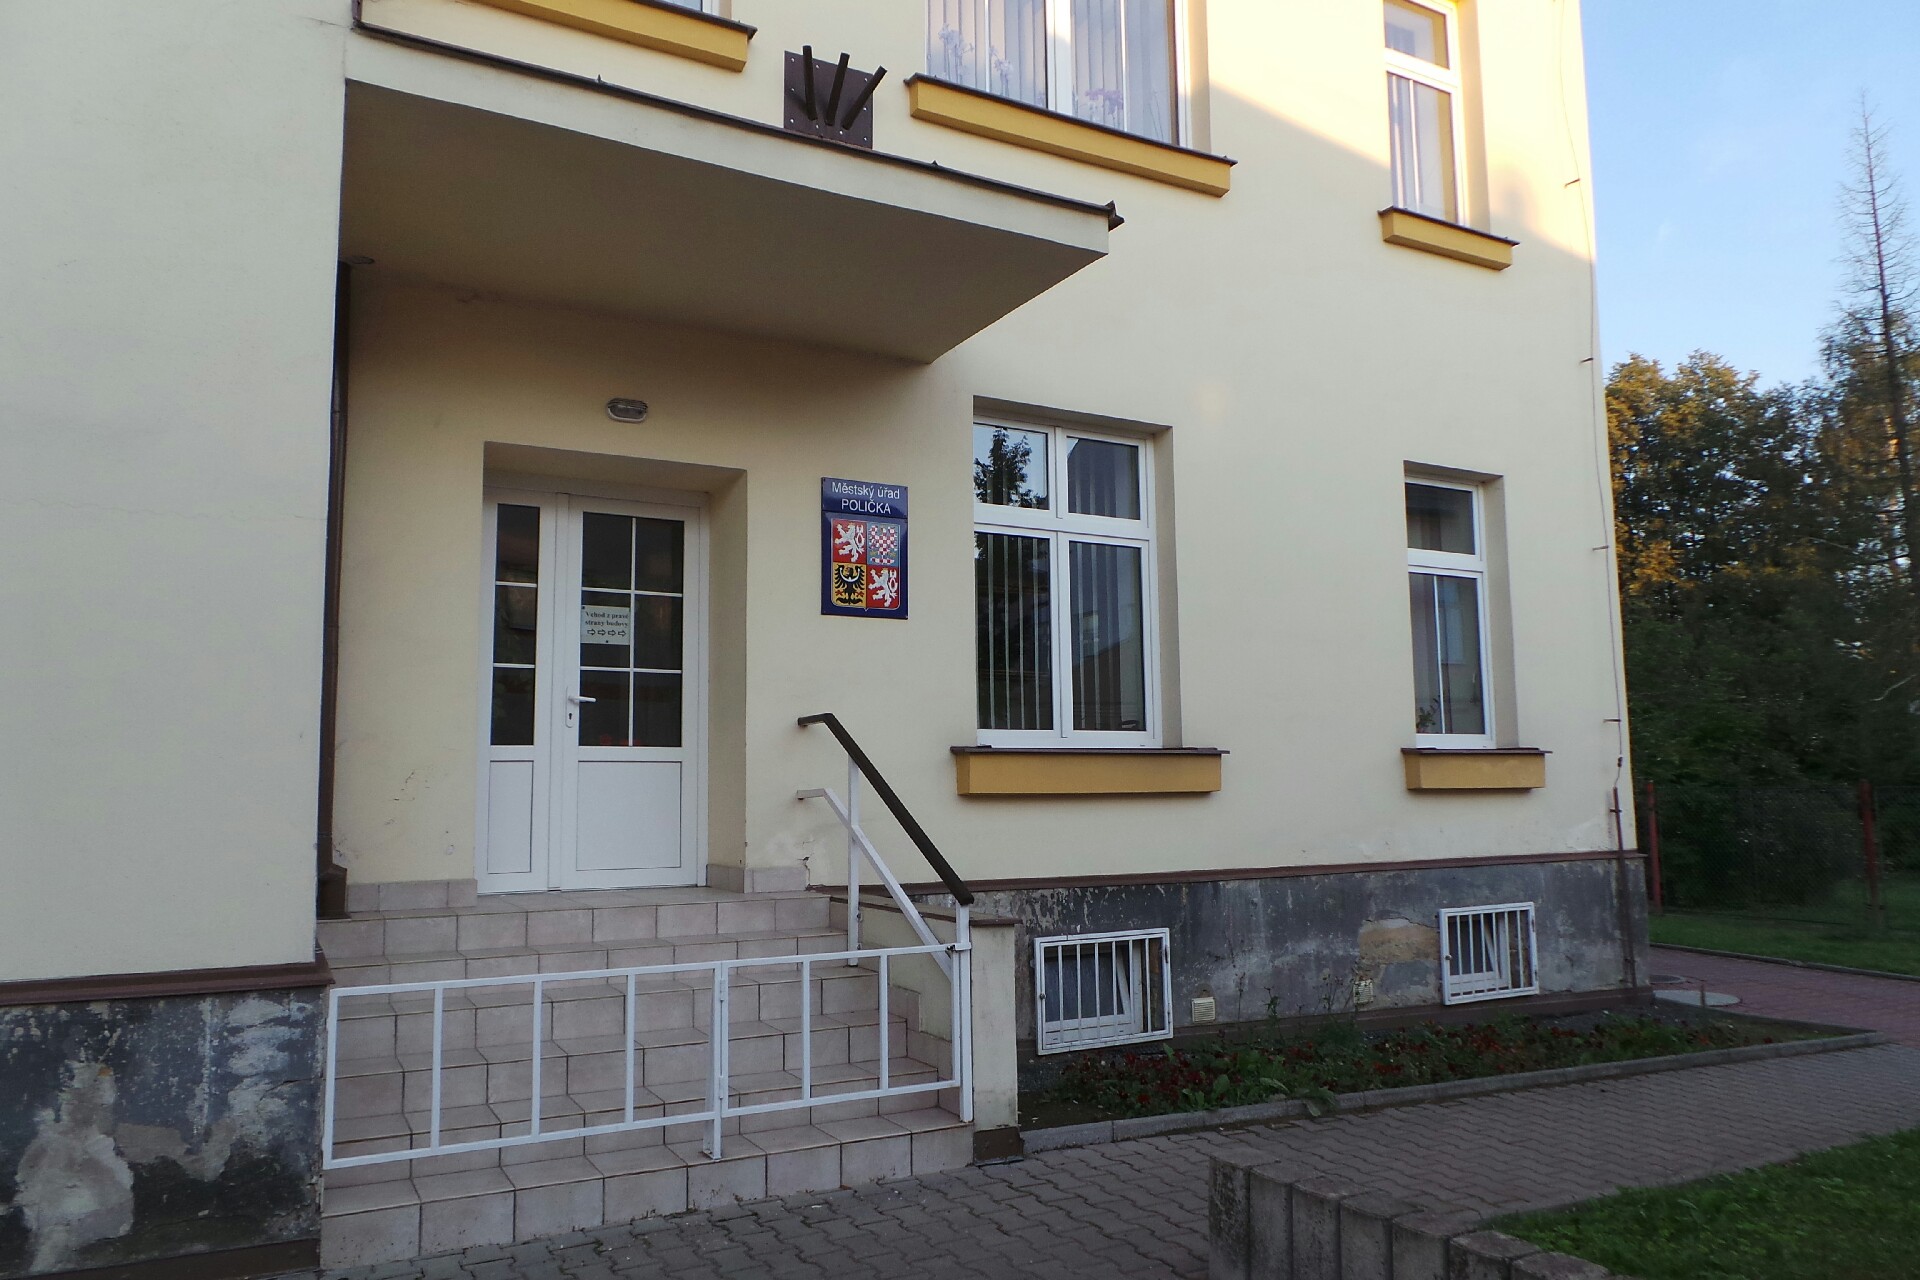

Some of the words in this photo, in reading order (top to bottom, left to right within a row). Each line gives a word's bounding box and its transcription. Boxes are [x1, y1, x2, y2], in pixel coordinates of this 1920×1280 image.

[832, 482, 874, 499] Městský
[877, 485, 900, 499] úřad
[841, 498, 891, 514] POLIČKA
